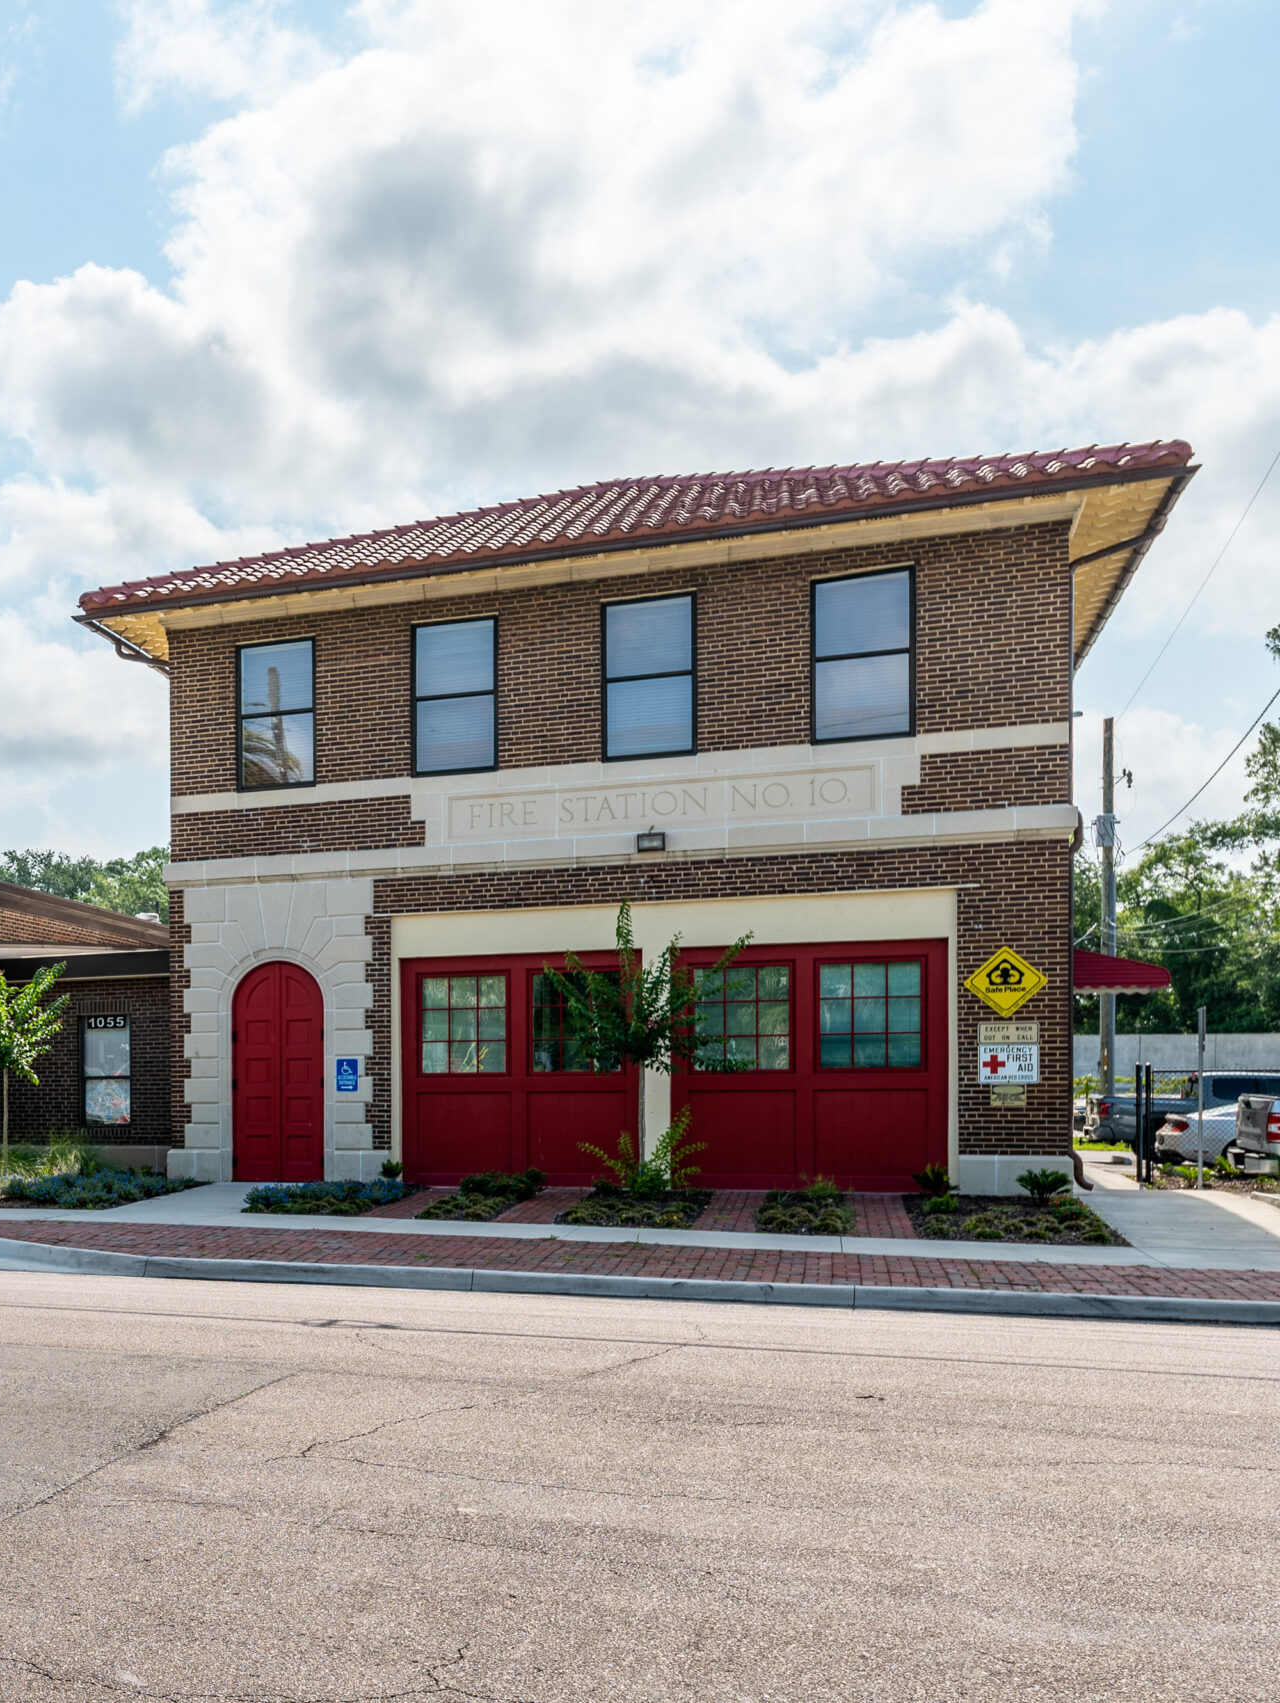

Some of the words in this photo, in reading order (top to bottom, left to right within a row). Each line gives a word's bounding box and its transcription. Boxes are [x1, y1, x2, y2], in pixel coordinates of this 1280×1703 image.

[469, 800, 538, 829] FIRE
[559, 787, 708, 824] STATION
[731, 782, 793, 812] NO.
[985, 986, 1003, 994] Safe
[1004, 985, 1027, 993] Place
[88, 1016, 125, 1028] 1055
[983, 1046, 1033, 1054] EMERGENCY
[1006, 1053, 1033, 1063] FIRST
[1017, 1063, 1034, 1072] AID
